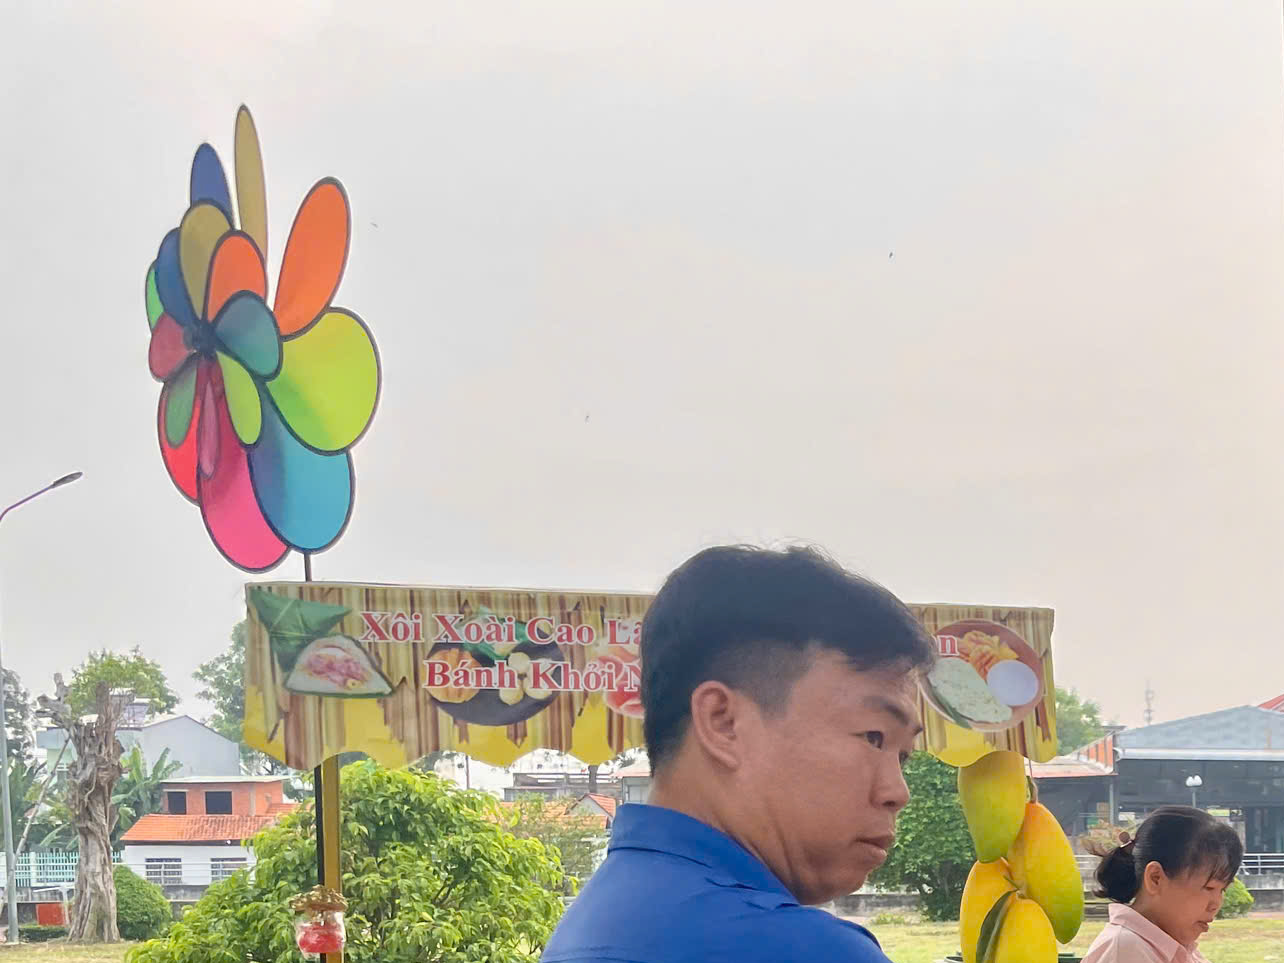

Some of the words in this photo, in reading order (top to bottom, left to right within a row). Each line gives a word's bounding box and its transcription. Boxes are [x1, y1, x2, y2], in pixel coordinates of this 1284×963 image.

[361, 612, 423, 642] Xôi
[432, 613, 516, 643] Xoài
[527, 616, 594, 645] Cao
[425, 660, 518, 689] Bánh
[530, 661, 617, 692] Khởi
